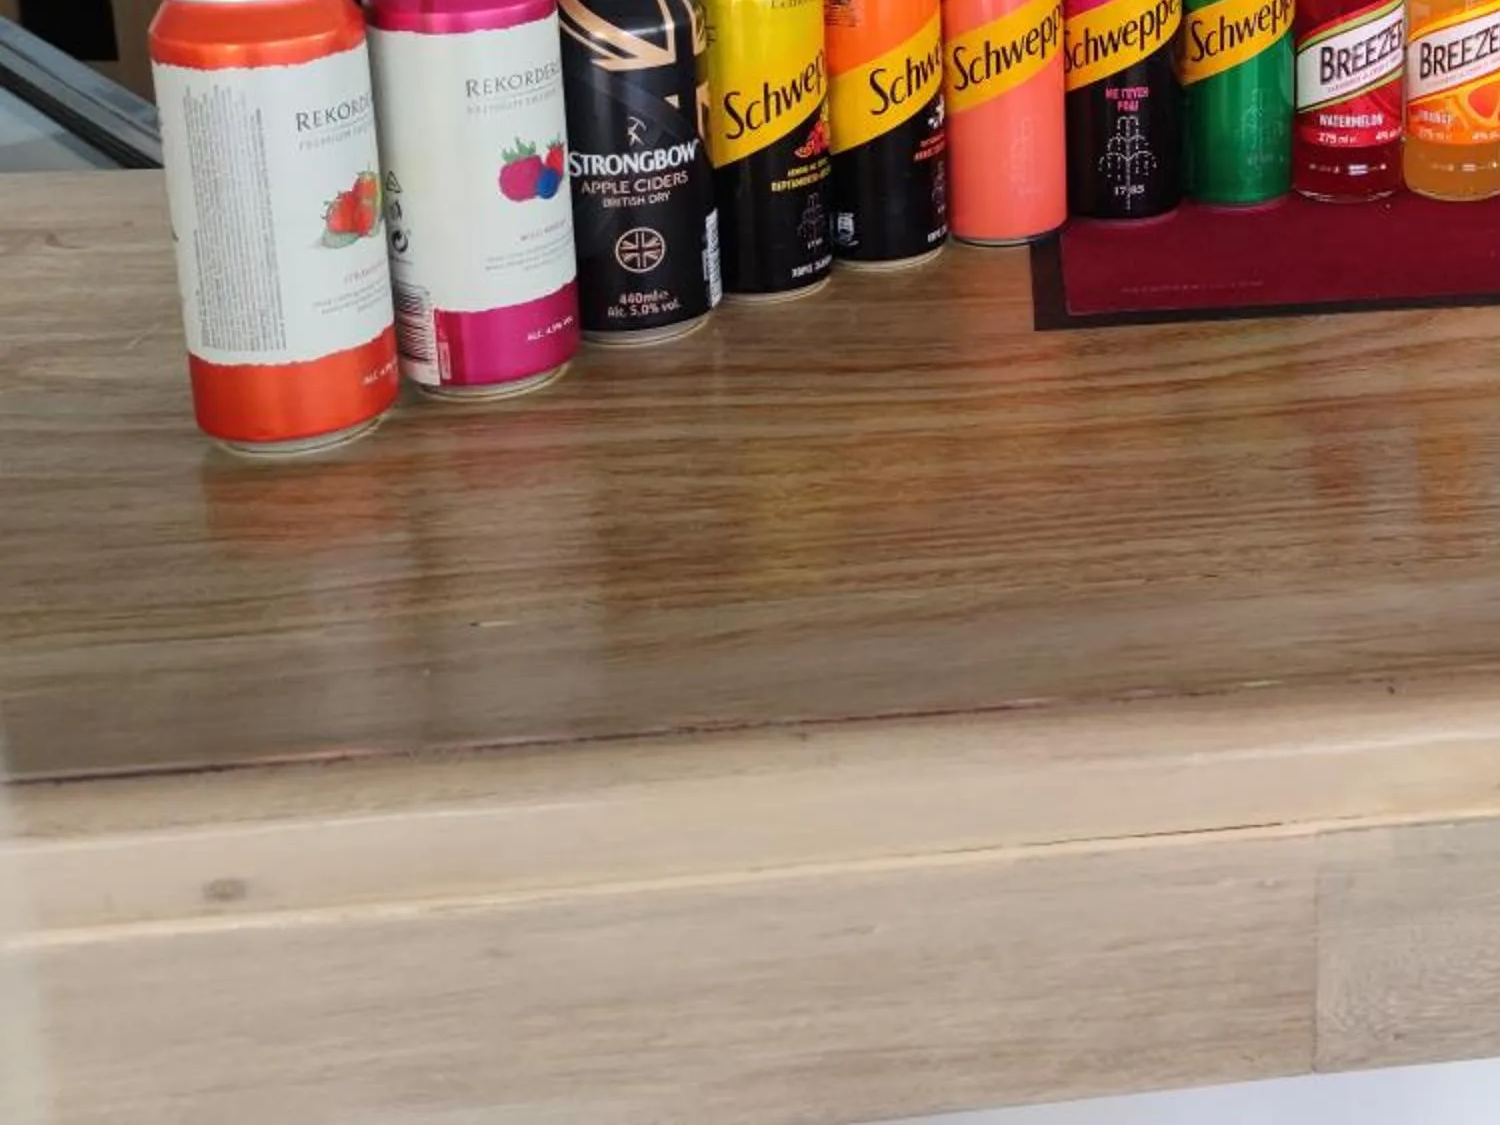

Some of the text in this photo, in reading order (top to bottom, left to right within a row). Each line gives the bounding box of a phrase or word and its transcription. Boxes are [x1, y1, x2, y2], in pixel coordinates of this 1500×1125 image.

[1319, 114, 1385, 129] WATERMELON
[568, 139, 700, 177] STRONGBOW
[581, 170, 689, 195] APPLE CIDERS
[603, 191, 671, 209] BRITISH DRY
